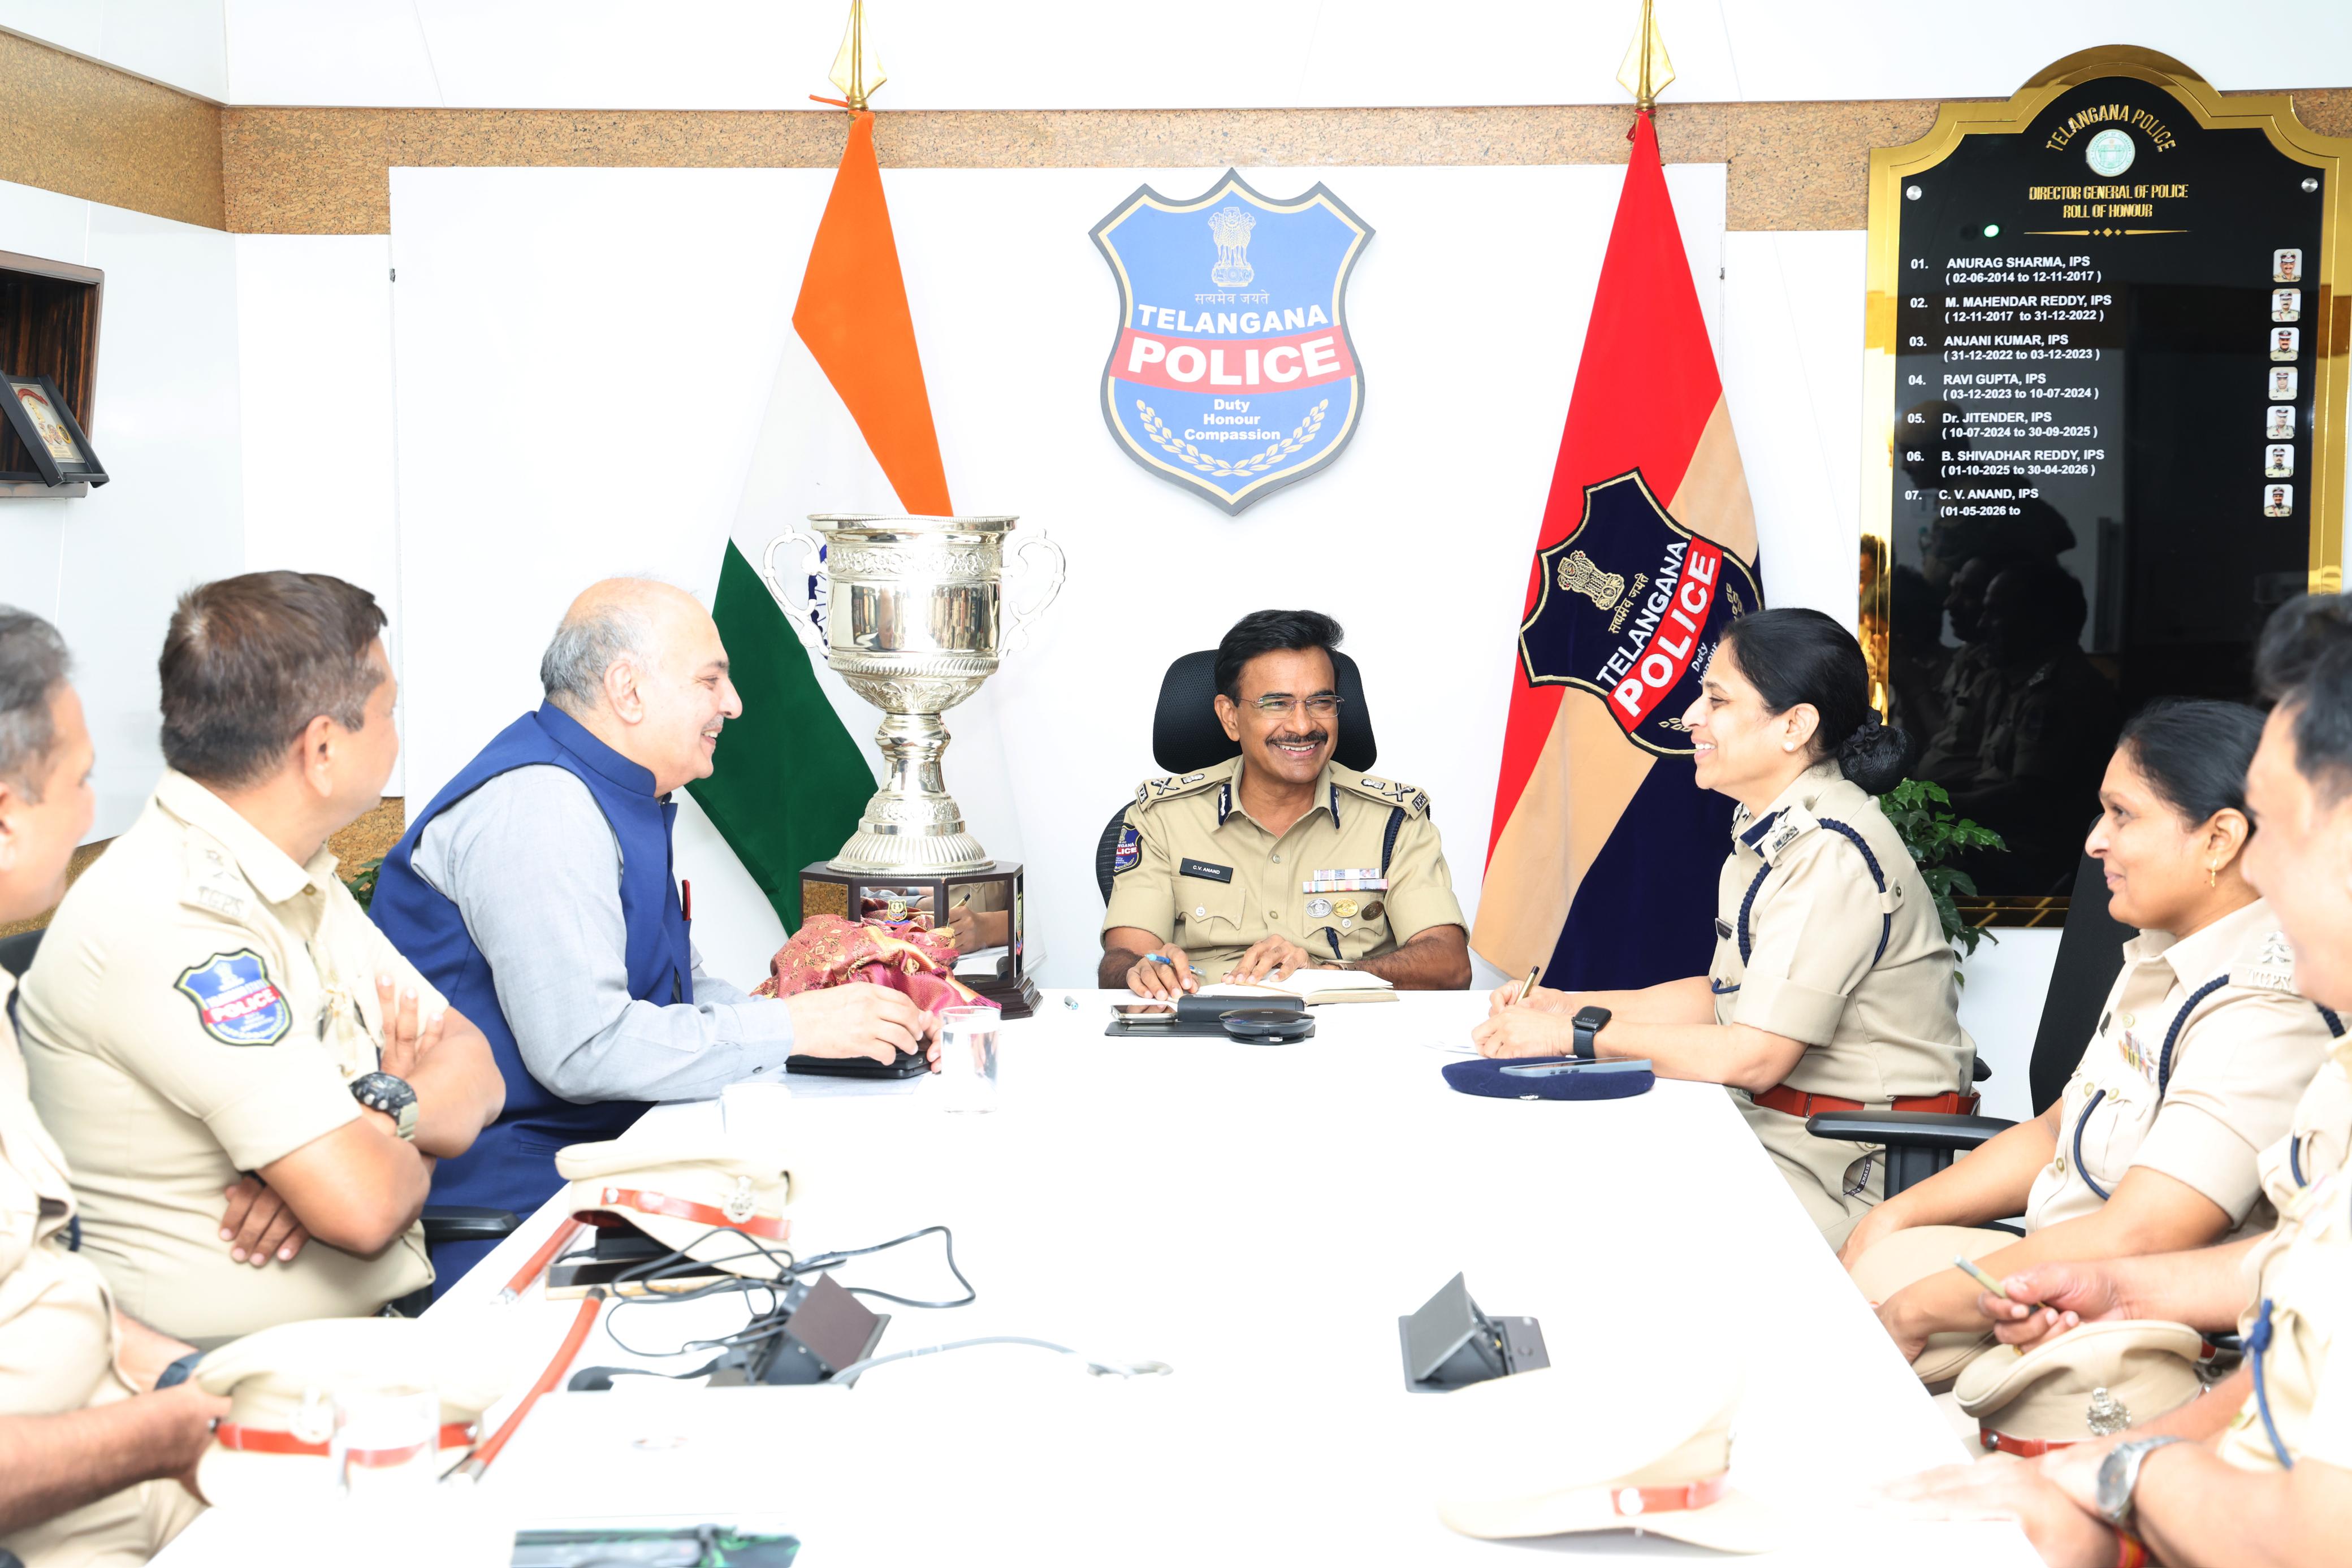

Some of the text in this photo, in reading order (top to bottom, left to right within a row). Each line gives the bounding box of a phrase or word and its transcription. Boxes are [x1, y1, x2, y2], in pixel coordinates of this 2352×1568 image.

[2046, 104, 2176, 153] TELANGANA POLICE
[2029, 184, 2189, 200] DIRECTOR GENERAL OF POLICE
[2063, 203, 2152, 218] ROLL OF HONOUR
[1911, 256, 2090, 269] 01. ANURAG SHARMA, IPS
[1953, 272, 2014, 283] 02-06-2014
[2017, 273, 2029, 281] to
[2033, 271, 2094, 281] 12-11-2017
[1195, 289, 1270, 305] सत्यमेव जयते
[1910, 295, 2111, 307] 02. M. MAHENDAR REDDY, IPS
[1138, 304, 1329, 334] TELANGANA
[1953, 311, 2013, 321] 12-11-2017
[2020, 311, 2031, 320] to
[2034, 310, 2096, 320] 31-12-2022
[1909, 335, 2068, 346] 03. ANJANI KUMAR, IPS
[1127, 336, 1341, 385] POLICE
[1951, 350, 2013, 360] 31-12-2022
[2016, 350, 2027, 359] to
[2030, 349, 2092, 359] 03-12-2023
[1908, 373, 2046, 385] 04. RAVI GUPTA, IPS
[1950, 388, 2012, 399] 03-12-2023
[2014, 389, 2026, 398] to
[2030, 388, 2091, 398] 10-07-2024
[1213, 399, 1250, 413] Duty
[1203, 414, 1261, 425] Honour
[1908, 412, 2052, 424] 05. Dr. JITENDER, IPS
[1184, 428, 1281, 443] Compassion
[1950, 427, 2011, 437] 10-07-2024
[2013, 428, 2025, 436] to
[2029, 426, 2090, 436] 30-09-2025
[1907, 449, 2104, 461] 06. B. SHIVADHAR REDDY, IPS
[1949, 465, 2010, 475] 01-10-2025
[2013, 466, 2025, 474] to
[2027, 465, 2088, 474] 30-04-2026
[1905, 488, 2038, 500] 07. C. V. ANAND, IPS
[1940, 506, 2020, 517] (01-05-2026 to
[1596, 542, 1688, 687] TELANGANA
[1614, 551, 1716, 717] POLICE
[1692, 642, 1707, 672] Duty
[210, 989, 276, 1022] POLICE
